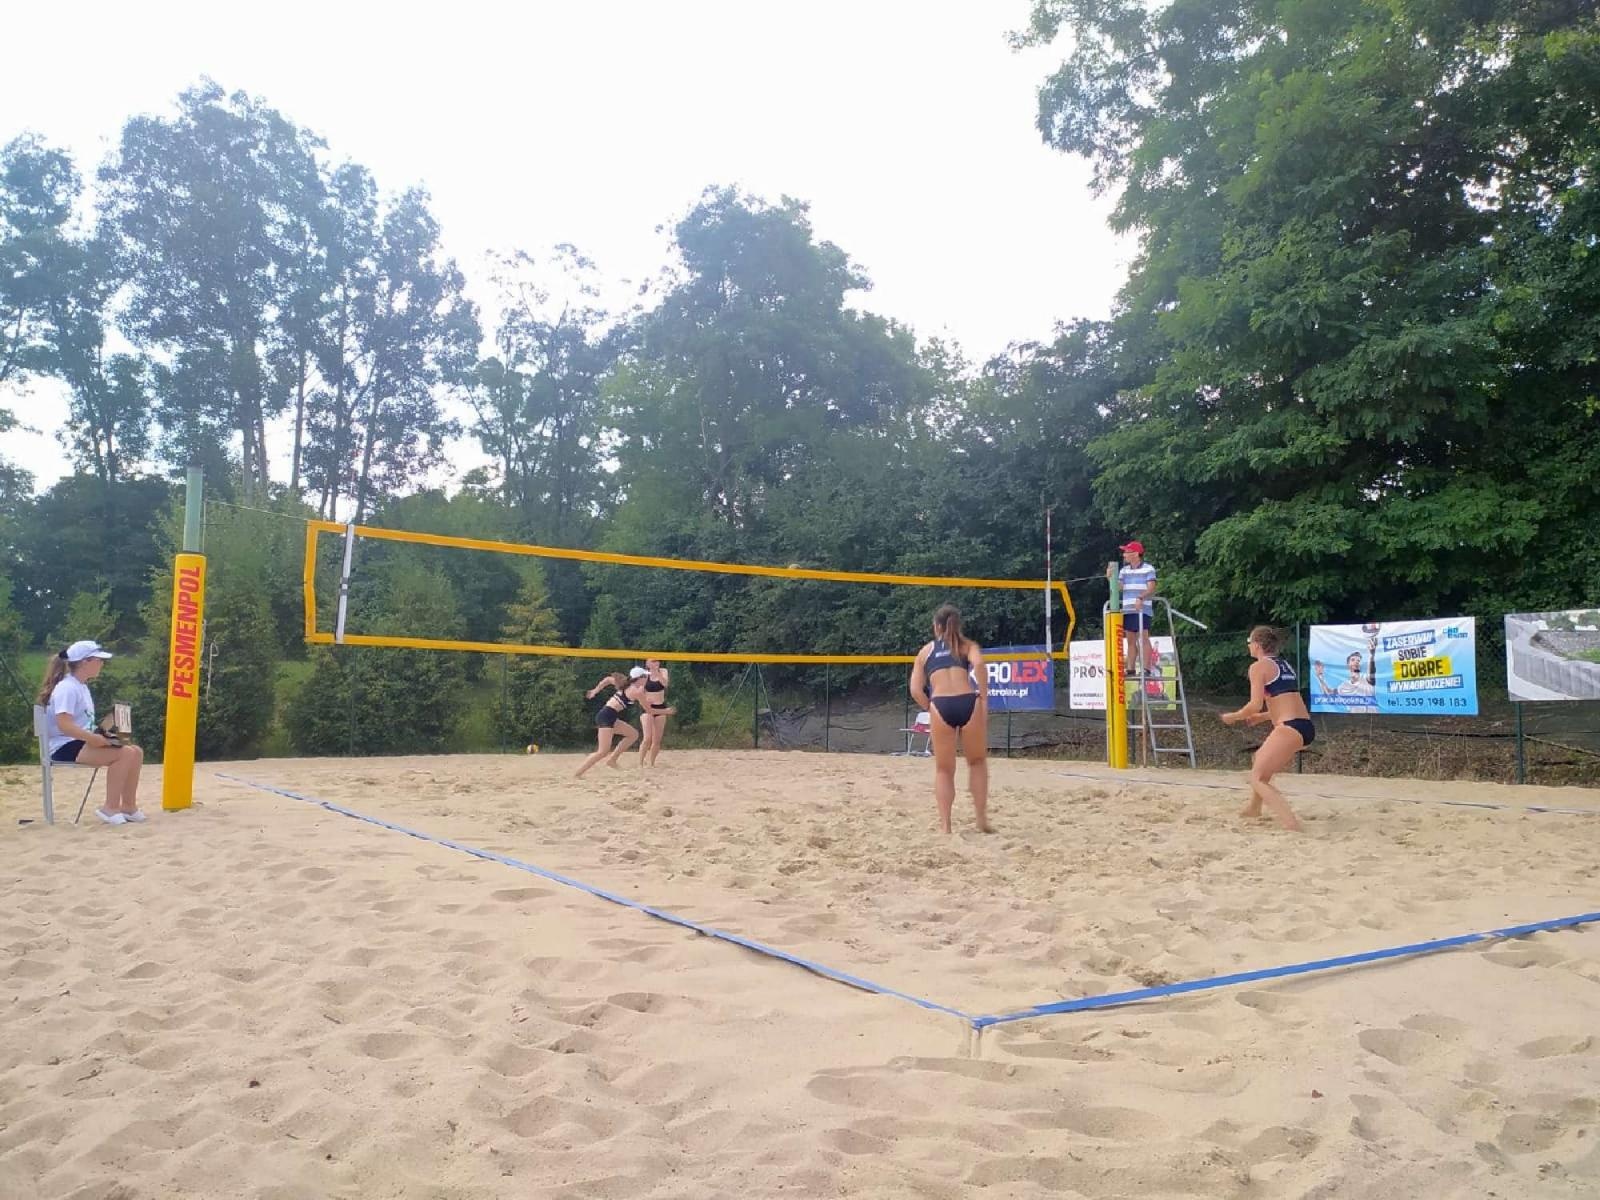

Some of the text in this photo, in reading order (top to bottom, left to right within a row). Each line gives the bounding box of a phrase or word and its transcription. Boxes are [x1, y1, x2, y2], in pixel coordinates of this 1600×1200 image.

[172, 566, 200, 698] PESMENPOL
[1397, 646, 1428, 661] SOBIE
[969, 661, 1048, 684] ROLEX
[1400, 659, 1444, 678] DOBRE
[1387, 697, 1402, 707] tel.
[1405, 697, 1424, 707] 539
[1427, 697, 1445, 707] 198
